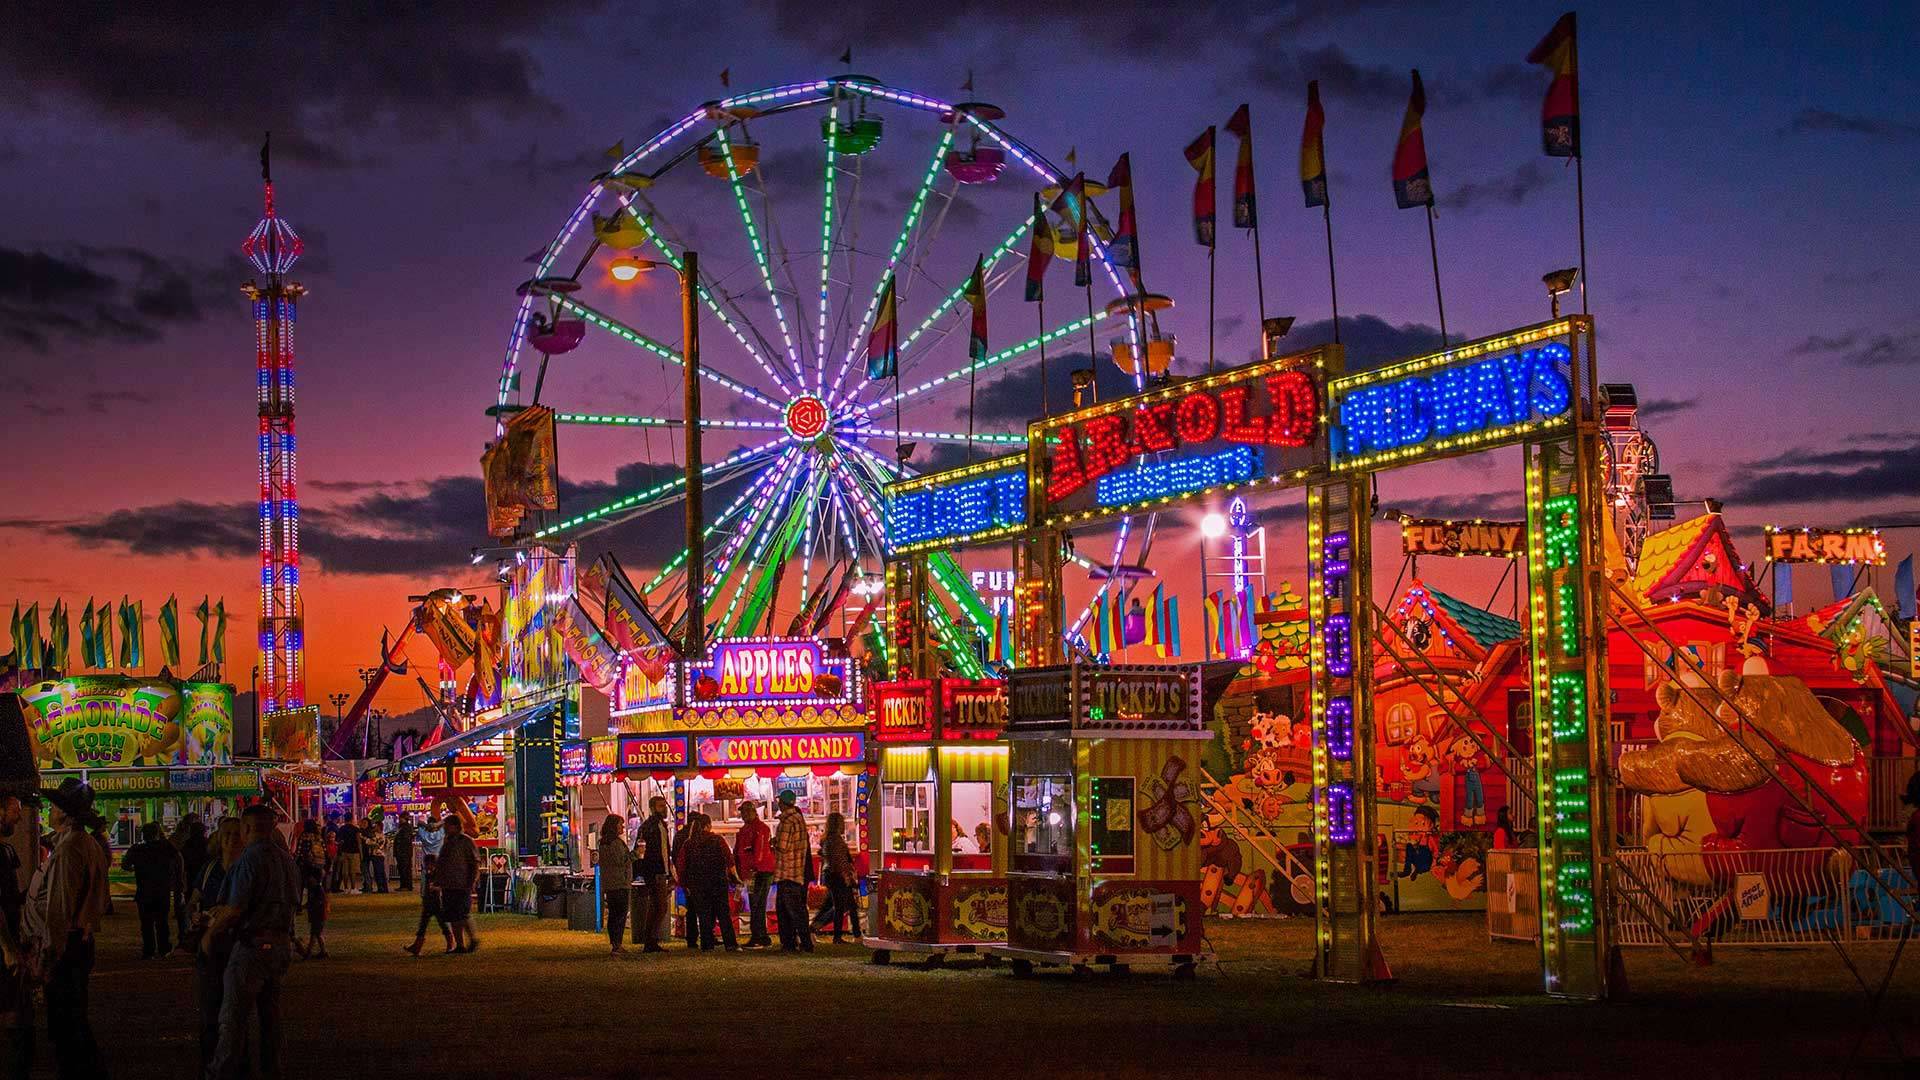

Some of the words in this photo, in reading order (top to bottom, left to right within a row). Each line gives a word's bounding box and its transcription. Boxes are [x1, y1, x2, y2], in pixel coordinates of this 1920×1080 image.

[1344, 342, 1571, 456] MIDWAYS
[1046, 370, 1318, 503] ARNOLD
[1407, 524, 1521, 552] FUNNY
[1772, 534, 1878, 560] FARM
[720, 648, 813, 696] APPLES
[1095, 680, 1182, 715] TICKETS
[1323, 531, 1356, 846] FOOD
[33, 699, 169, 744] LEMONADE
[883, 696, 926, 728] TICKET
[1544, 494, 1593, 935] RIDES
[73, 732, 126, 749] CORN
[639, 742, 669, 754] COLD
[727, 737, 793, 761] COTTON
[797, 735, 854, 759] CANDY
[75, 747, 123, 764] DOGS
[628, 751, 682, 765] DRINKS
[93, 776, 124, 791] CORN
[128, 775, 161, 789] DOGS
[458, 769, 505, 783] PRET
